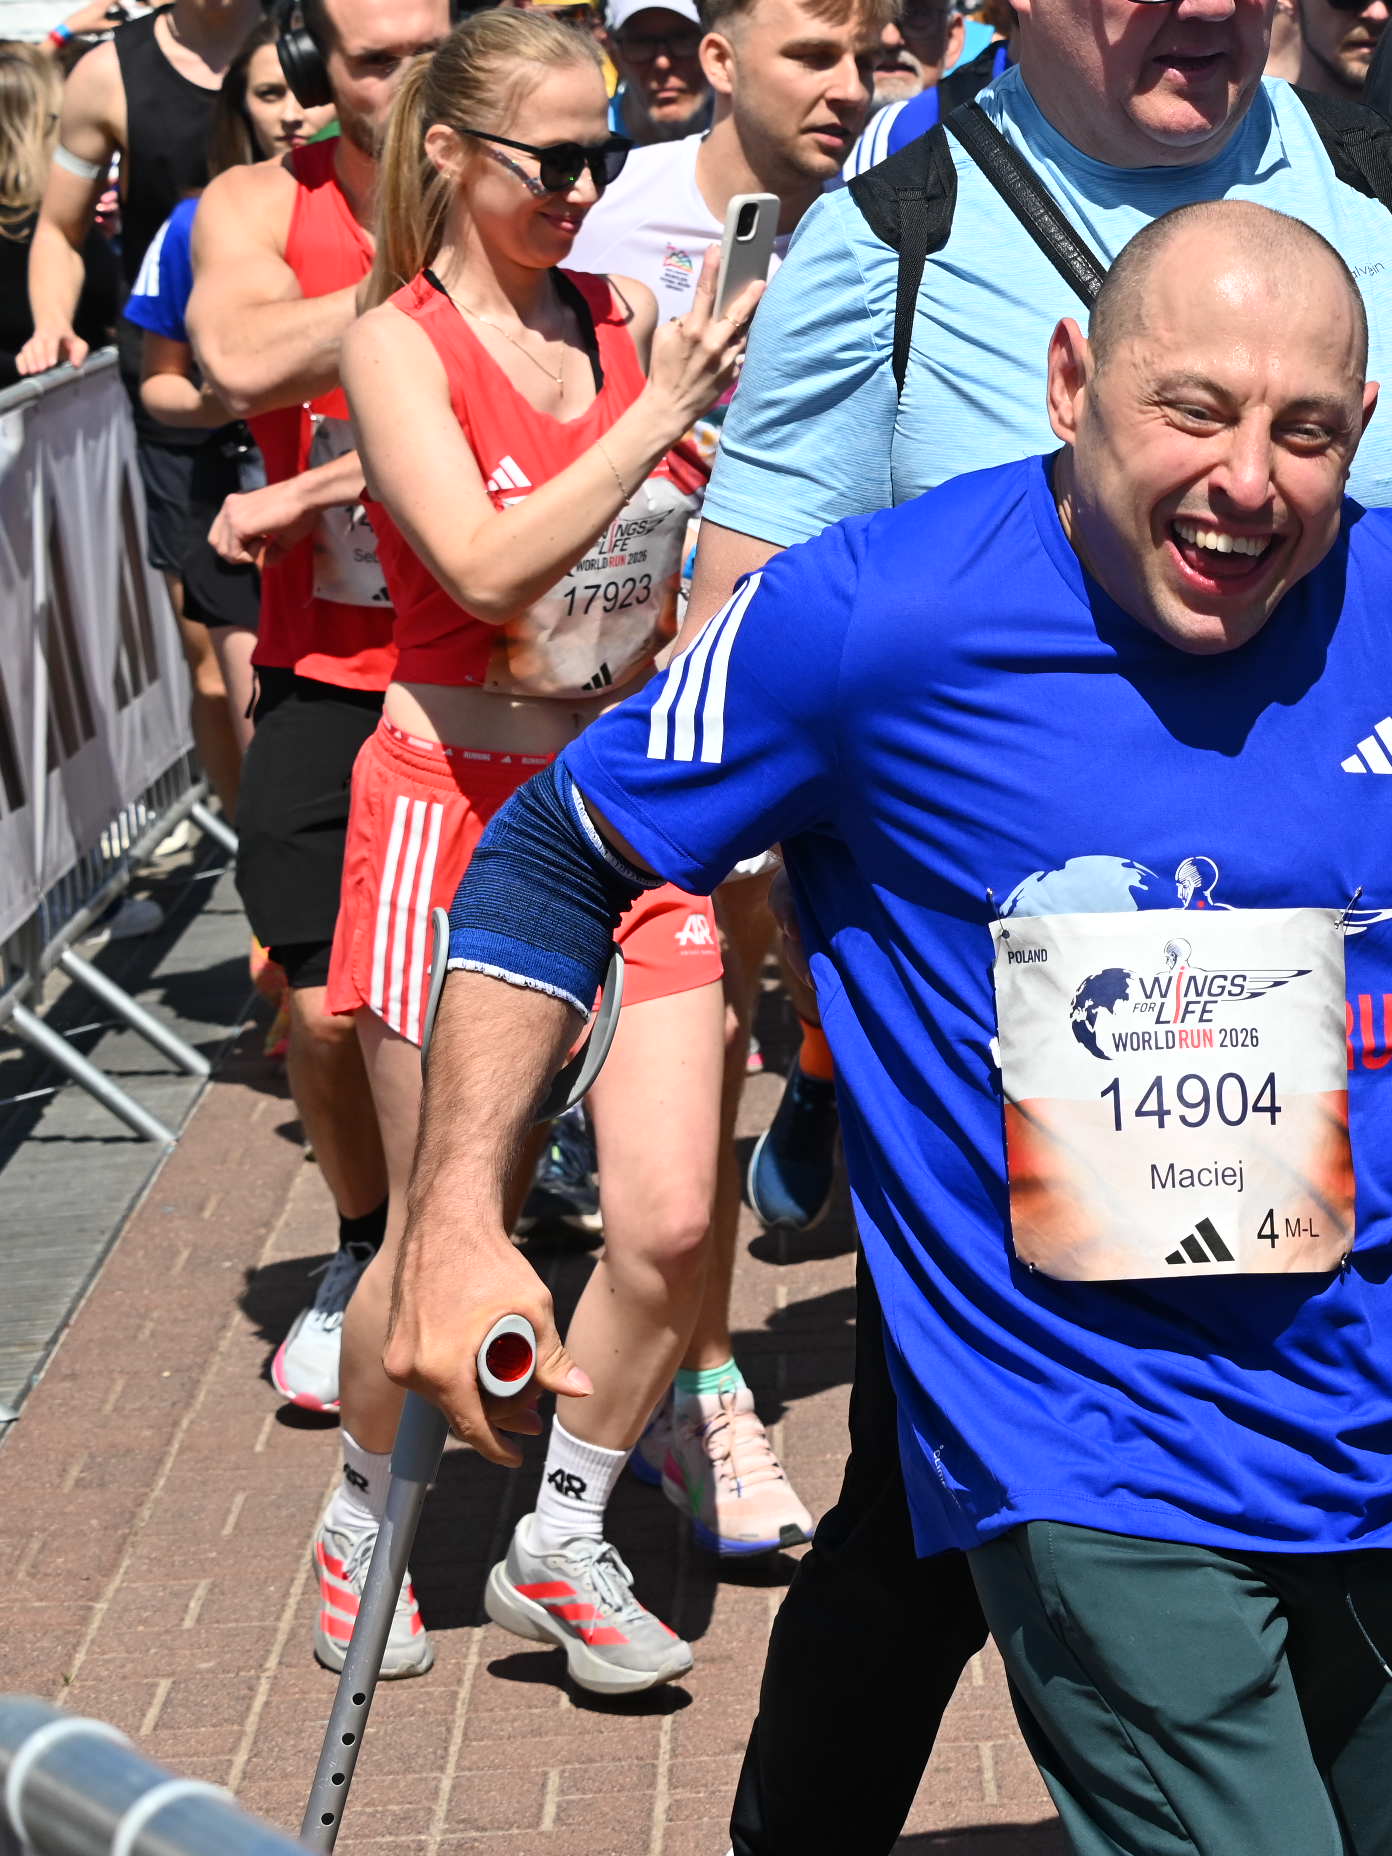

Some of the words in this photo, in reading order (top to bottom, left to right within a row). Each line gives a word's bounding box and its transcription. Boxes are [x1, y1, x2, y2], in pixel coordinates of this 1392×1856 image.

[564, 574, 652, 617] 17923
[1007, 949, 1048, 964] POLAND
[1139, 966, 1248, 999] WINGS
[1133, 1002, 1157, 1013] FOR
[1155, 1000, 1218, 1025] LIFE
[1112, 1030, 1176, 1052] WORLD
[1178, 1029, 1214, 1049] RUN
[1219, 1028, 1259, 1048] 2026
[1100, 1071, 1282, 1132] 14904
[1150, 1160, 1244, 1192] Maciej
[1257, 1209, 1279, 1249] 4
[1285, 1217, 1320, 1239] M-L
